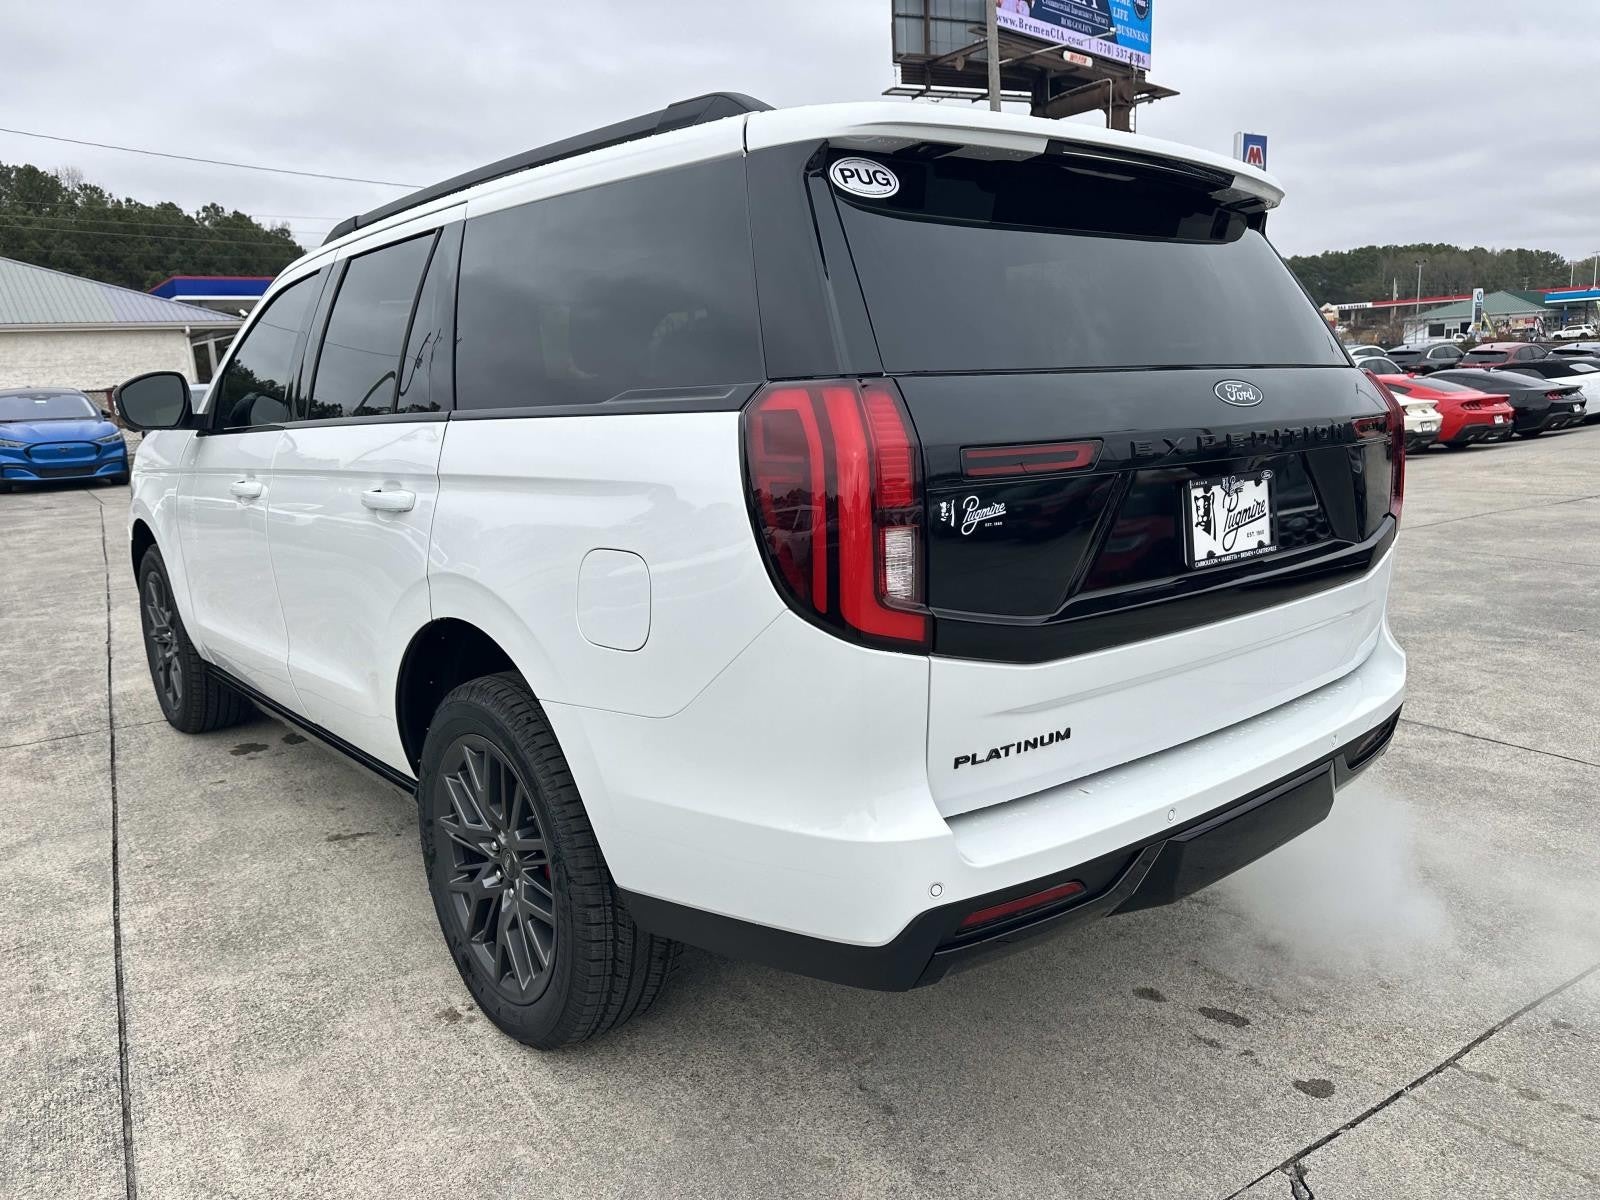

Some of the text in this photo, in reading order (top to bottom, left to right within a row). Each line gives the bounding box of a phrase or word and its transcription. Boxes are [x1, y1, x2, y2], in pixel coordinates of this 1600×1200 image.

[1112, 7, 1129, 21] LIFE
[1116, 23, 1149, 44] BUSINESS
[838, 167, 892, 187] PUG
[1225, 383, 1256, 401] Ford
[961, 495, 1007, 536] Pugmire
[1222, 491, 1267, 552] Pugmire
[953, 727, 1071, 770] PLATINUM
